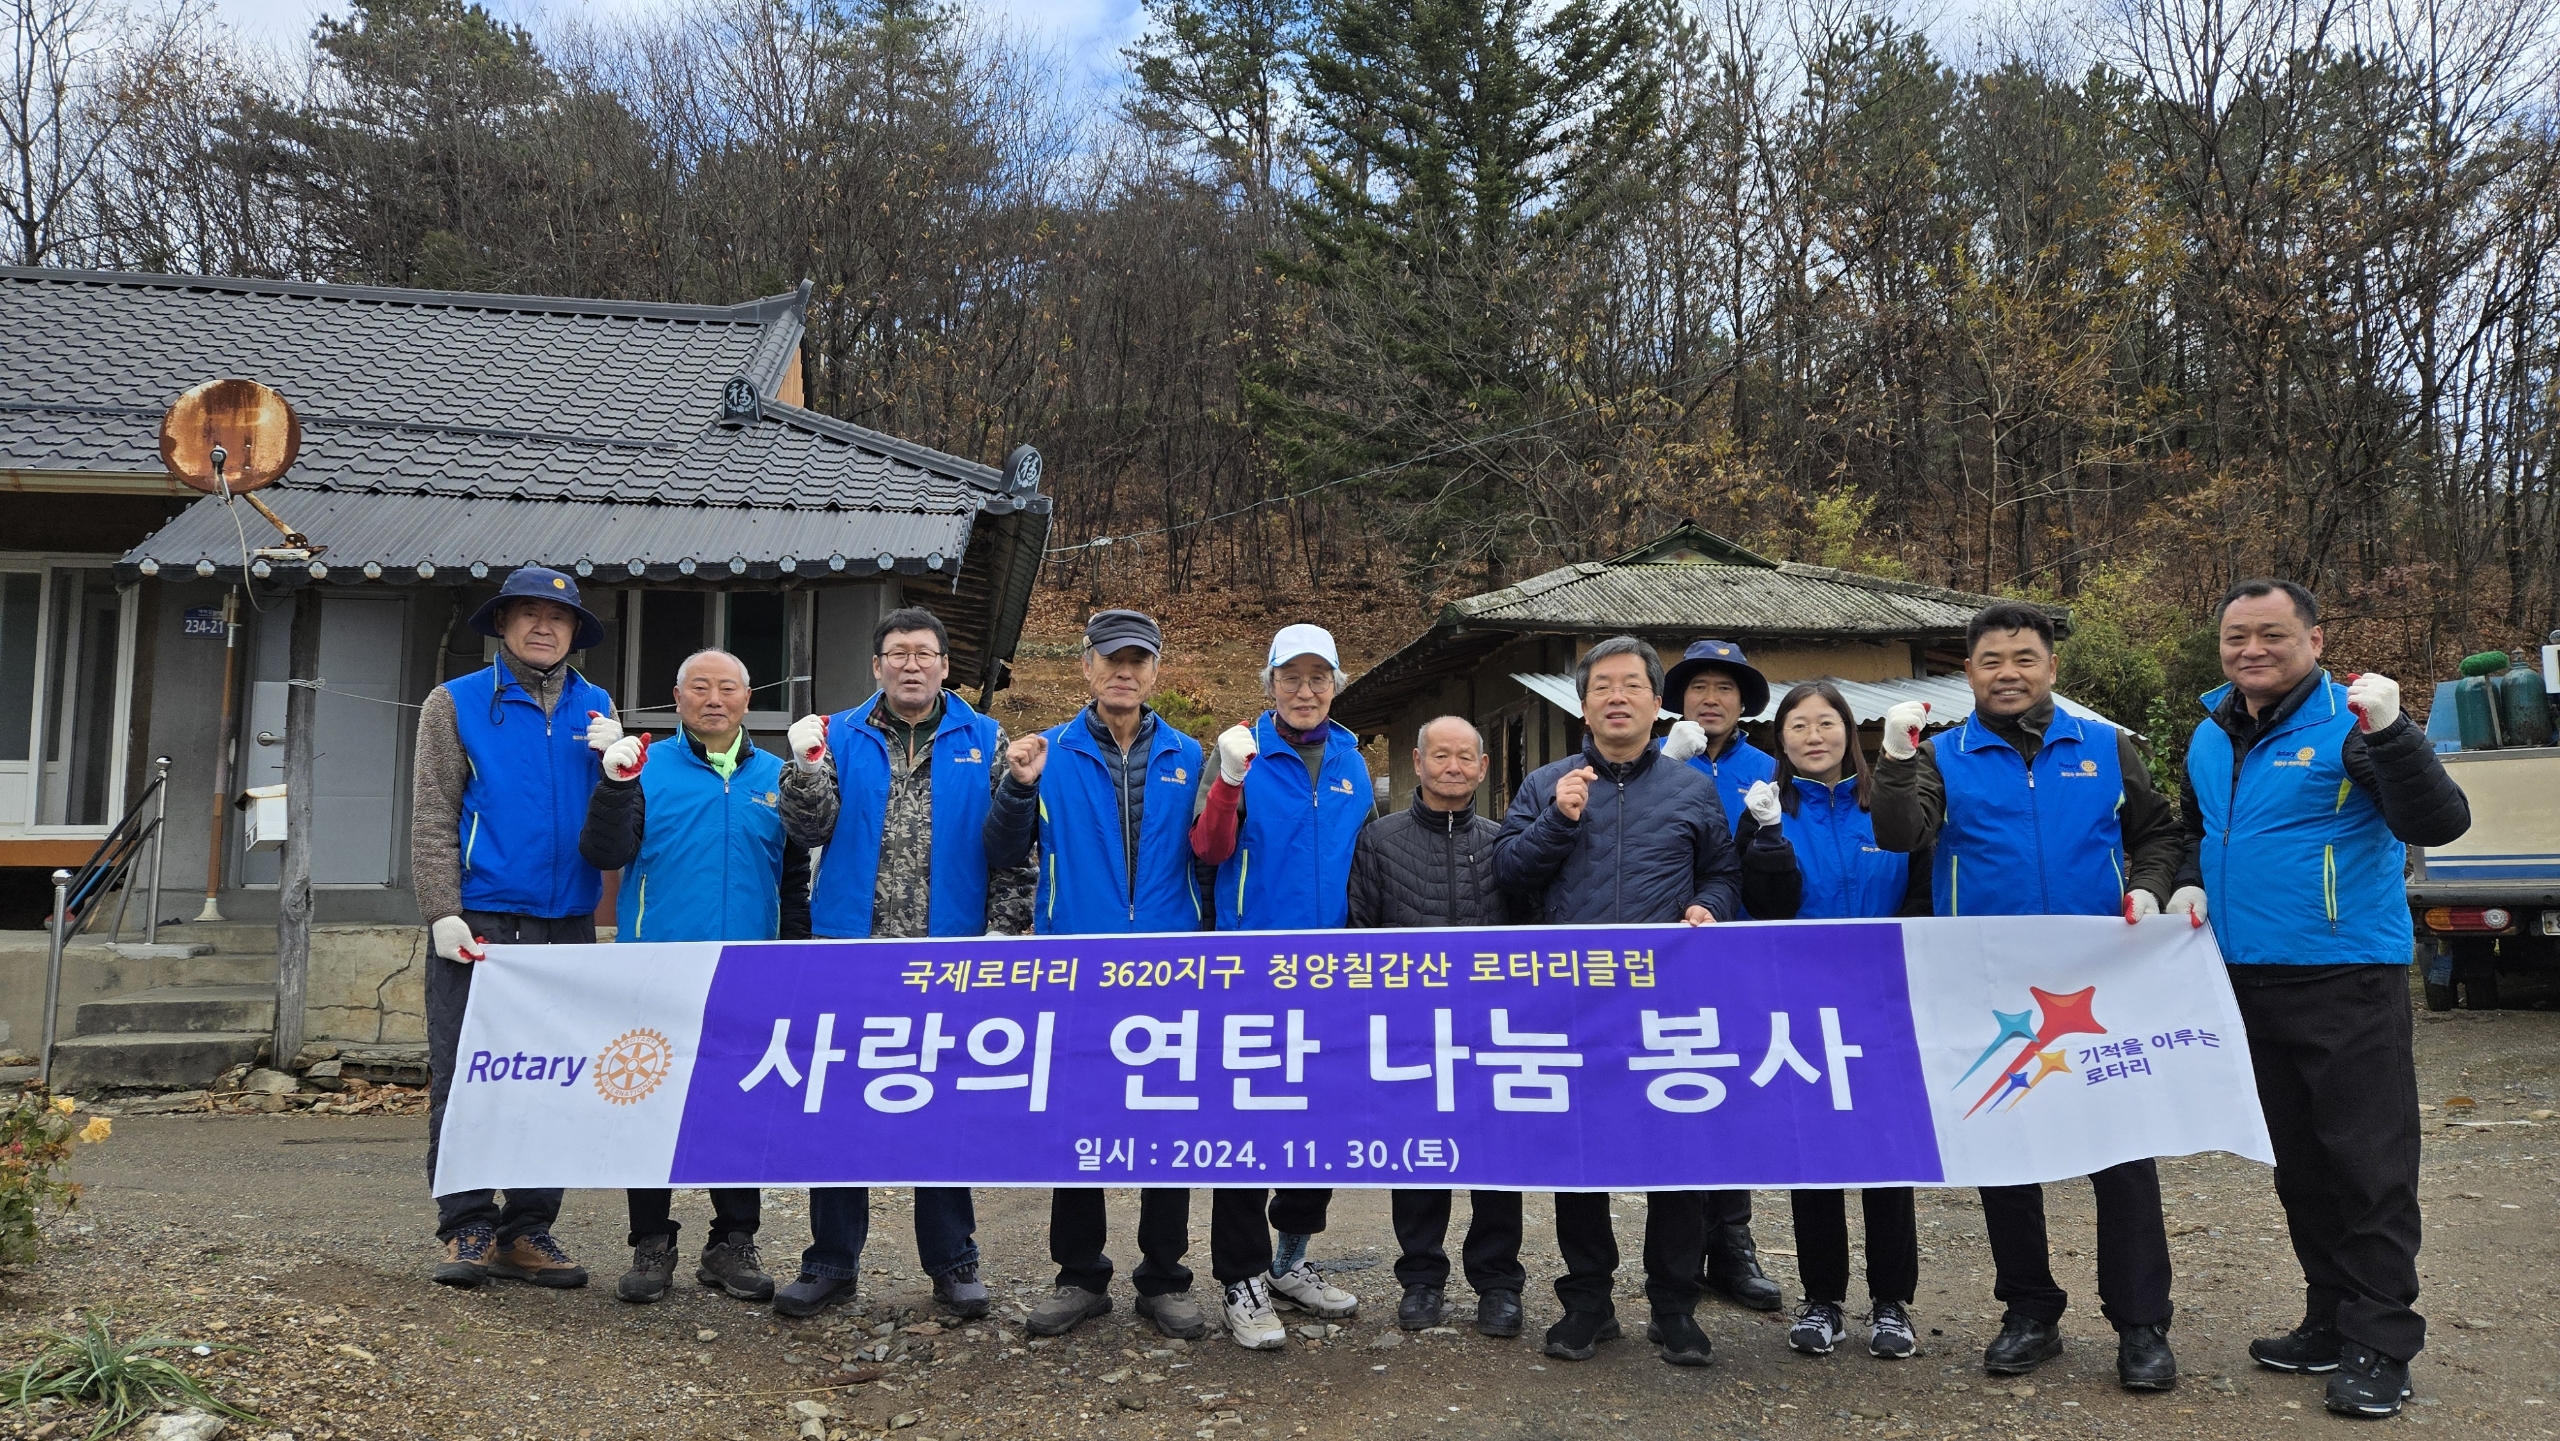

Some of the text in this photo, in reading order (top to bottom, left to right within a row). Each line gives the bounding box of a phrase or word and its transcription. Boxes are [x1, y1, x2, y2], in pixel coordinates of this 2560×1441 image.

[185, 619, 224, 634] 234-21
[900, 949, 1656, 994] 국제로타리 3620지구 청양칠갑산 로타리클럽
[624, 1035, 657, 1047] ROTARY
[2078, 1029, 2220, 1065] 기적을 이루는
[466, 1050, 588, 1087] Rotary
[738, 1007, 1864, 1114] 사랑의 연탄 나눔 봉사
[2086, 1057, 2152, 1086] 로타리
[602, 1076, 657, 1097] INTERNATIONAL
[1074, 1137, 1135, 1171] 일시
[1171, 1140, 1267, 1171] 2024.
[1282, 1140, 1332, 1171] 11.
[1346, 1138, 1460, 1173] 30.(토)
